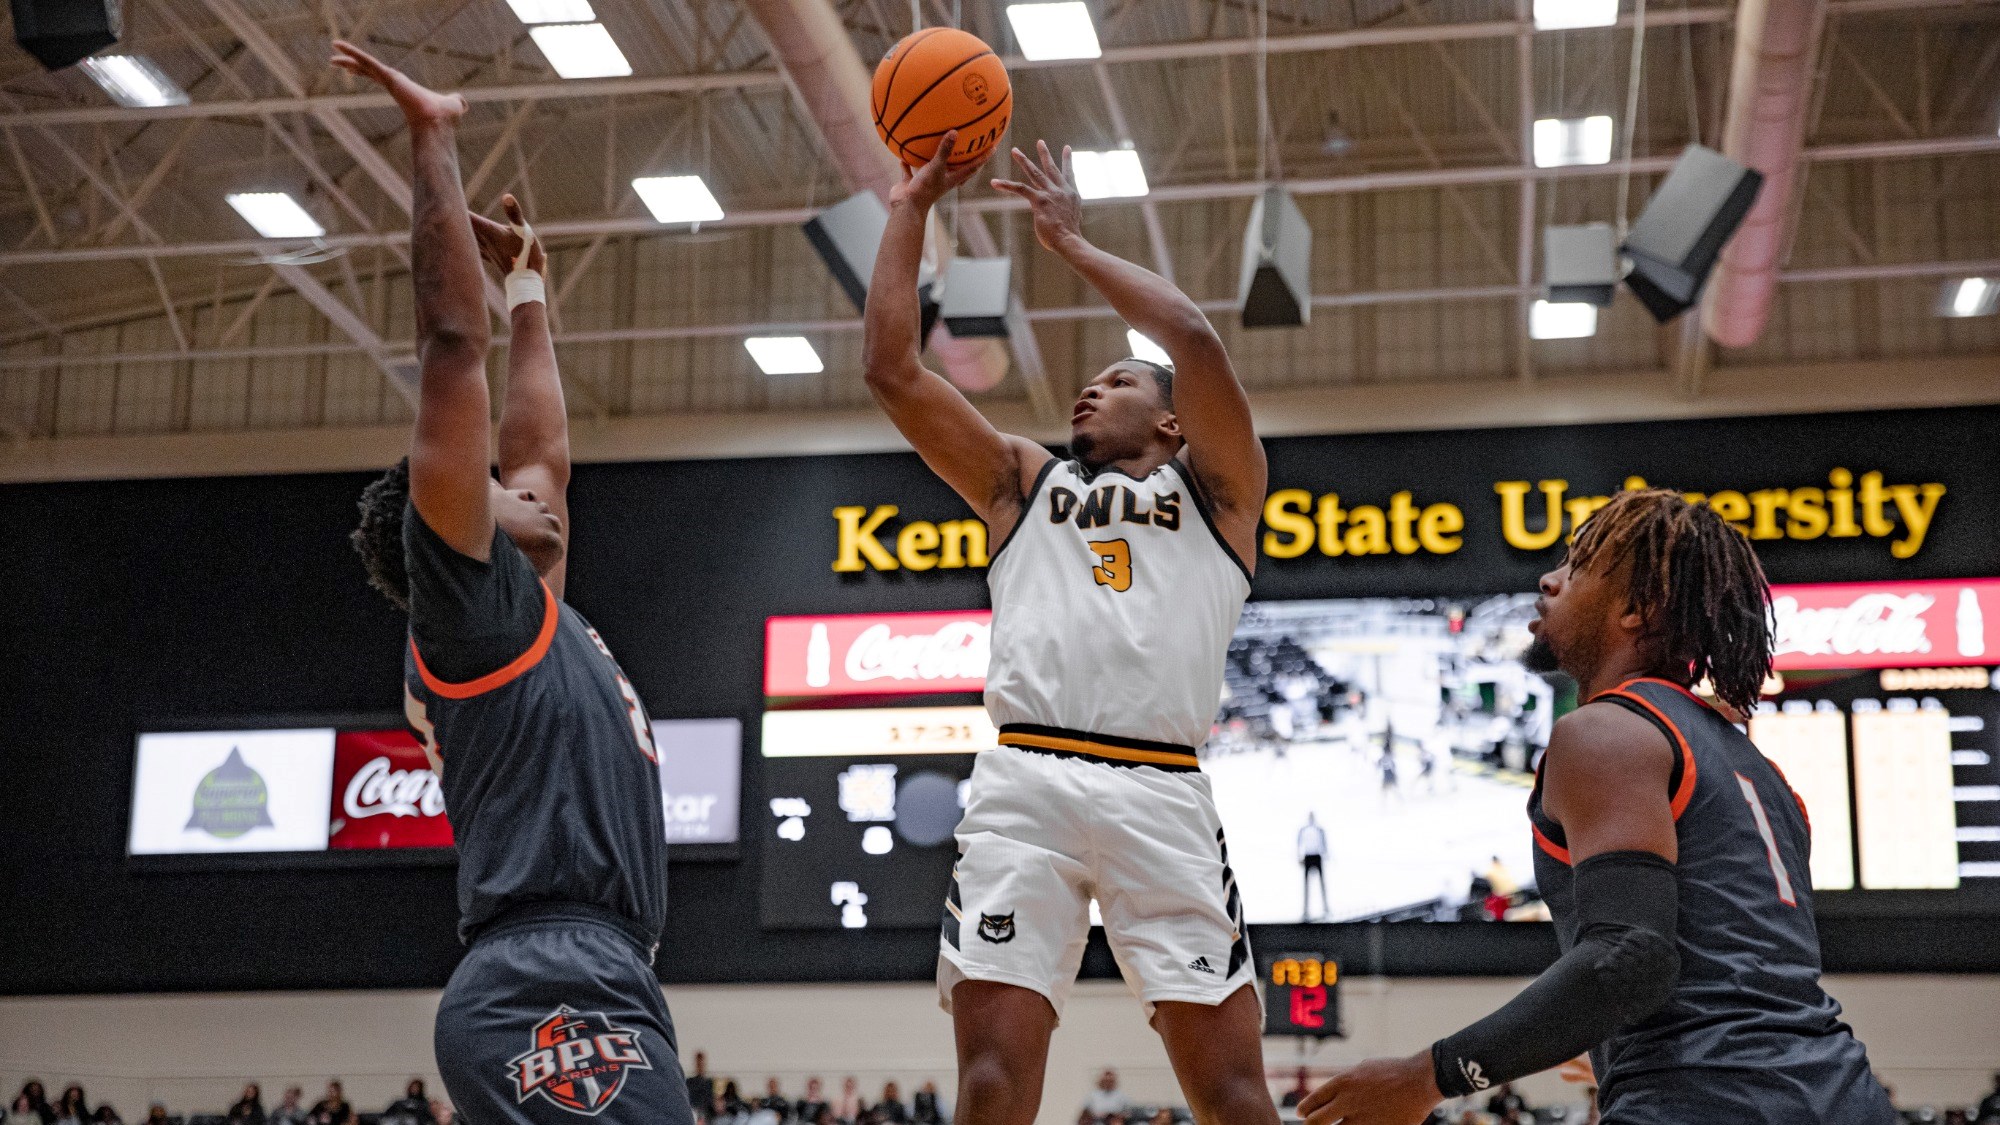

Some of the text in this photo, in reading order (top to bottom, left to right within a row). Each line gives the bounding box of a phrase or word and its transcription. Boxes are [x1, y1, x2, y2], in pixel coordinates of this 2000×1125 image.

[831, 466, 1947, 572] Ken State Uersity
[1050, 485, 1181, 532] OWLS
[1086, 537, 1133, 592] 3
[1733, 771, 1797, 909] 1
[519, 1033, 643, 1093] BPC
[545, 1063, 621, 1089] BARONS
